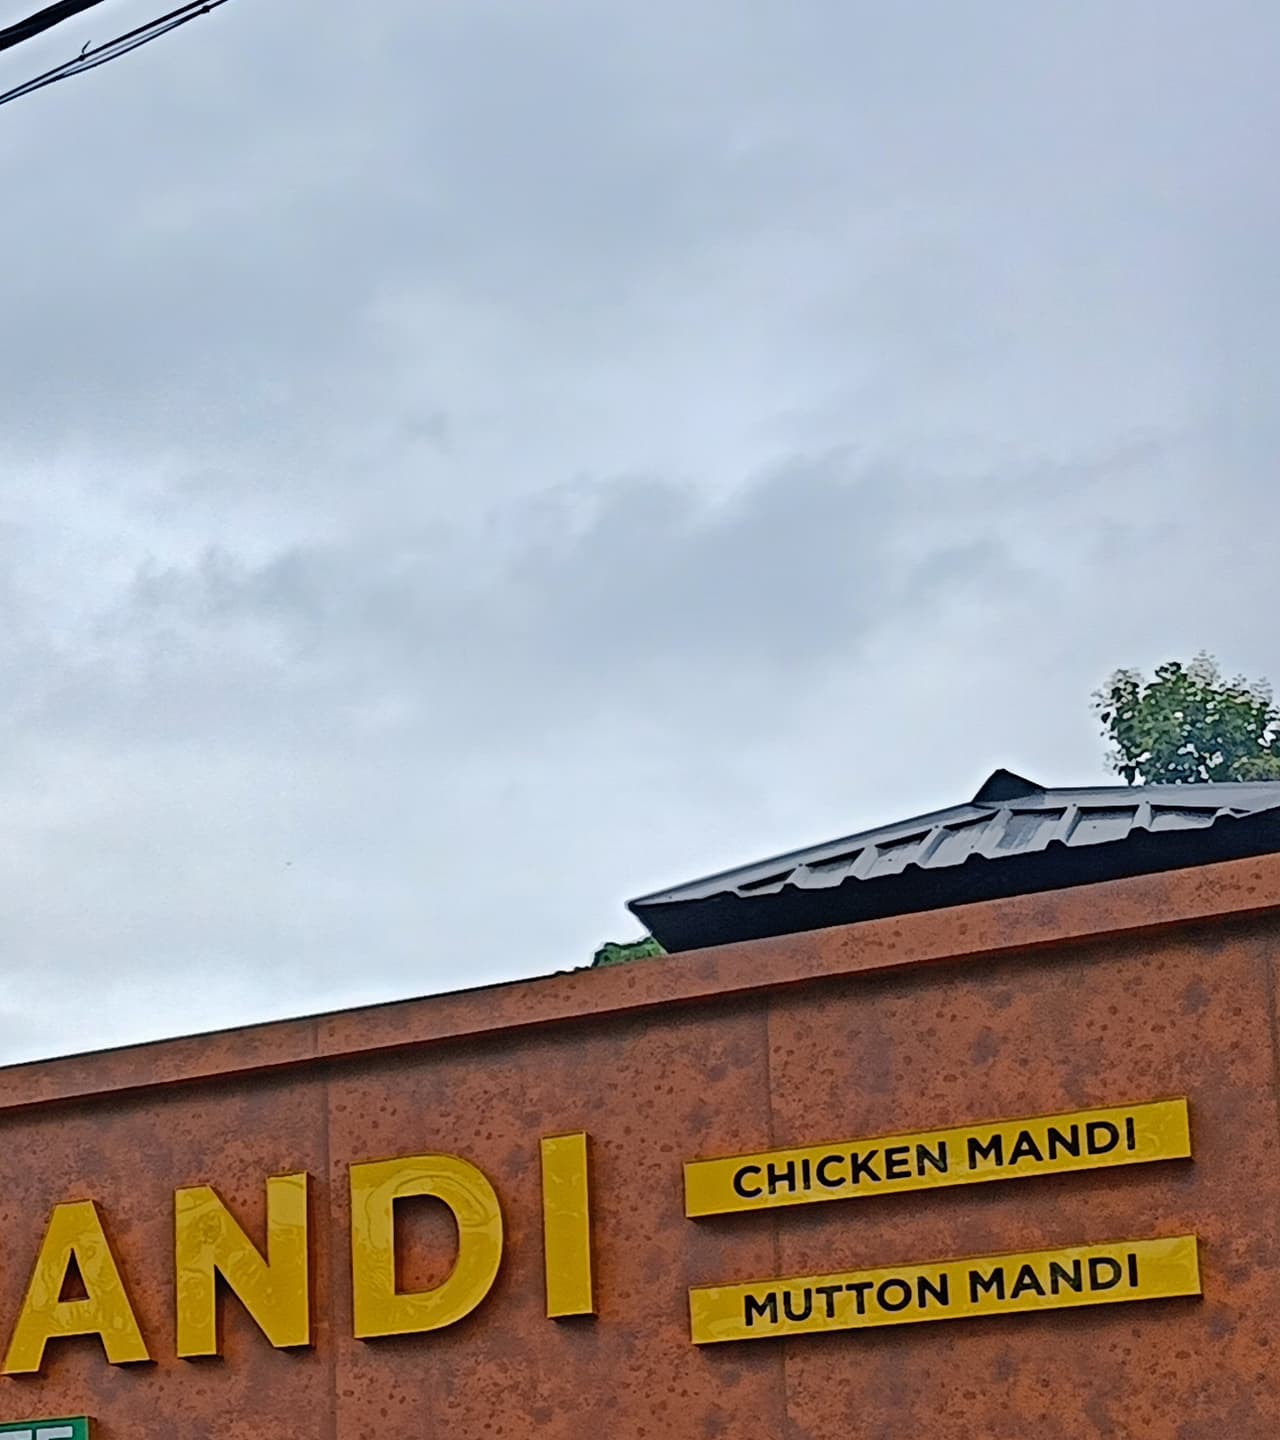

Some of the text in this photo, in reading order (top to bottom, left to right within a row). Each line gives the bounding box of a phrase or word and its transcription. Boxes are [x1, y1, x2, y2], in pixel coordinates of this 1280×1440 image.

[733, 1116, 1136, 1199] CHICKEN MANDI
[743, 1252, 1140, 1327] MUTTON MANDI
